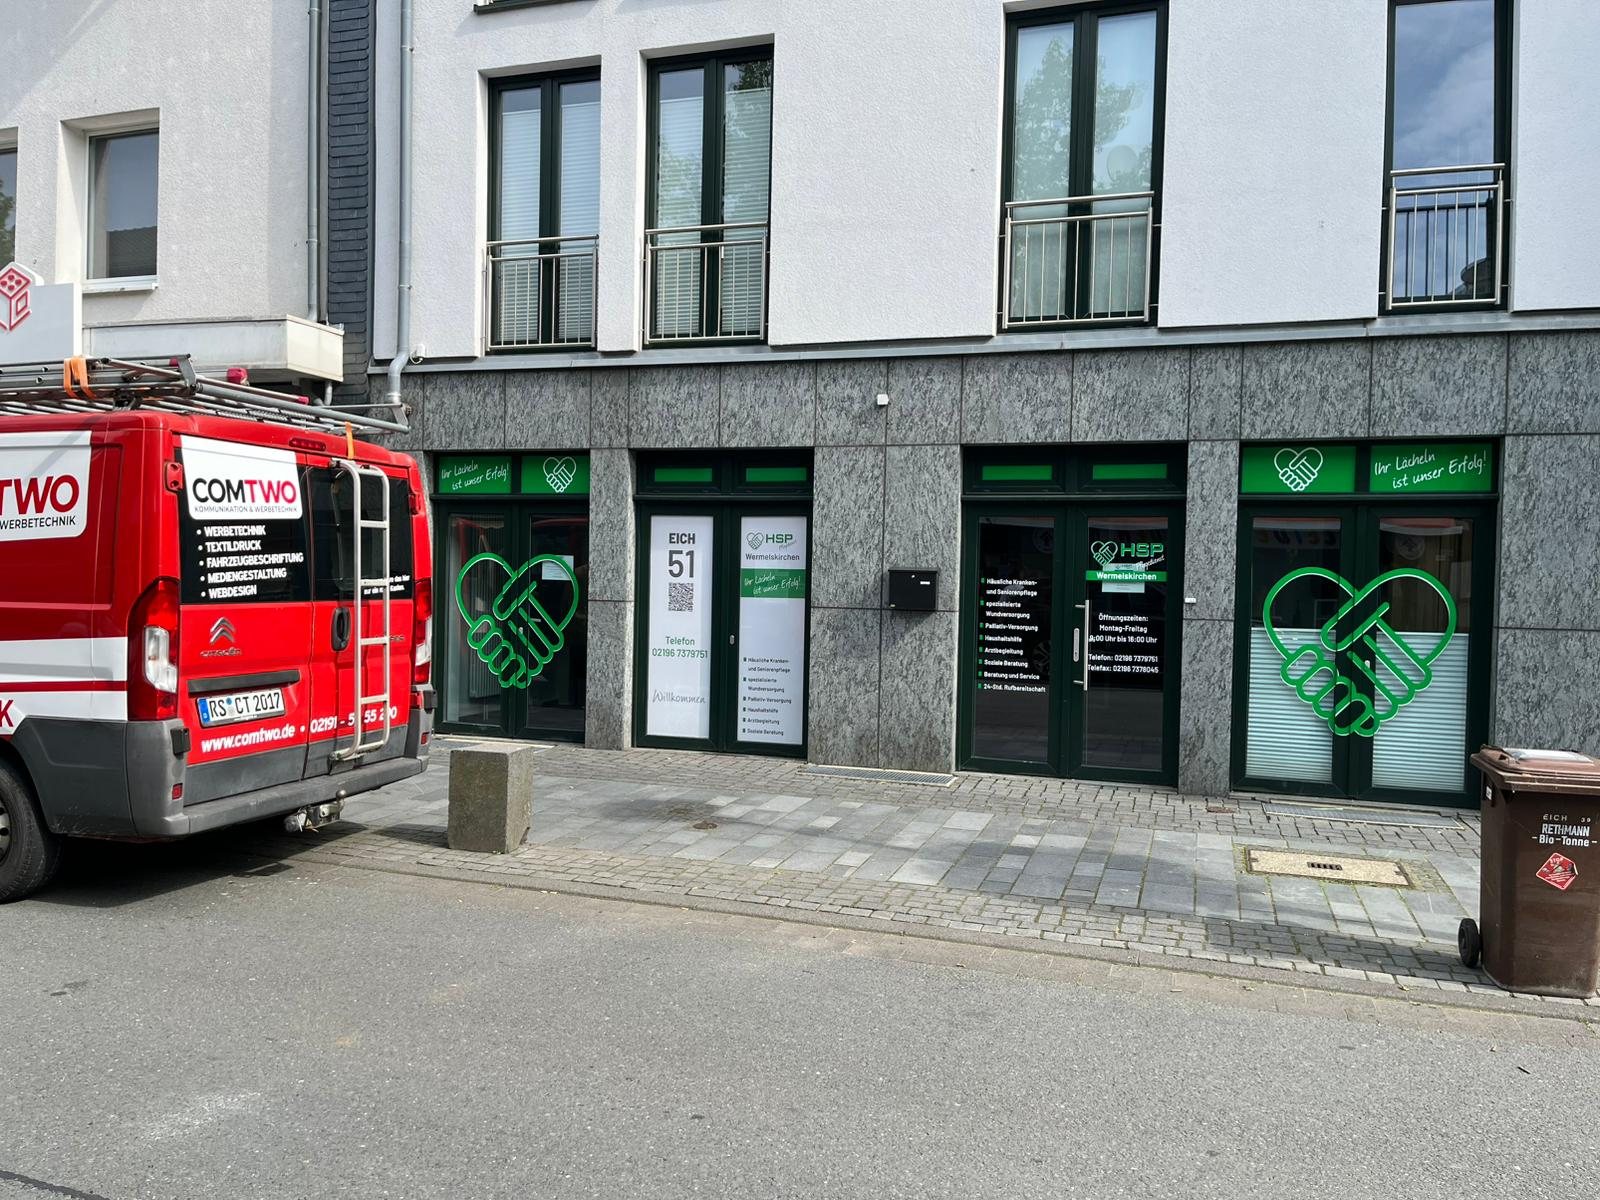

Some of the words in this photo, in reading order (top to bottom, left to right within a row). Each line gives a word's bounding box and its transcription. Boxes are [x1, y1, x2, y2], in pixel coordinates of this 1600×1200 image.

[1374, 462, 1391, 476] Ihr
[1396, 448, 1435, 470] Lächeln
[464, 474, 484, 486] unser
[486, 463, 509, 482] Erfolg!
[1392, 474, 1408, 488] ist
[1412, 468, 1444, 484] unser
[1448, 450, 1486, 474] Erfolg!
[192, 478, 297, 503] COMTWO
[204, 525, 266, 537] WERBETECHNIK
[668, 533, 696, 544] EICH
[766, 534, 793, 544] HSP
[206, 540, 262, 552] TEXTILDRUCK
[1120, 543, 1164, 558] HSP
[206, 552, 304, 568] FAHRZEUGBESCHRIFTUNG
[746, 553, 800, 561] Wermelskirchen
[668, 550, 694, 578] 51
[208, 568, 288, 584] MEDIENGESTALTUNG
[1096, 572, 1157, 580] Wermelskirchen
[208, 584, 258, 598] WEBDESIGN
[997, 589, 1038, 597] Seniorenpflege
[986, 611, 1030, 620] Wundversorgung
[1098, 612, 1148, 622] Öffnungszeiten:
[985, 622, 1038, 632] Palliativ-Versorgung
[1099, 624, 1148, 634] Montag-Freitag
[666, 636, 696, 646] Telefon
[652, 648, 676, 658] 02196
[676, 650, 708, 659] 7379751
[984, 648, 1024, 656] Arztbegleitung
[984, 672, 1008, 680] Beratung
[1004, 684, 1046, 692] Rufbereitschaft
[652, 689, 707, 704] Willkommen
[209, 700, 226, 718] RS
[234, 696, 250, 714] CT
[252, 692, 280, 712] 2017
[202, 723, 295, 754] www.comtwo.de
[310, 715, 338, 734] 02191
[1542, 823, 1590, 836] RETHMANN
